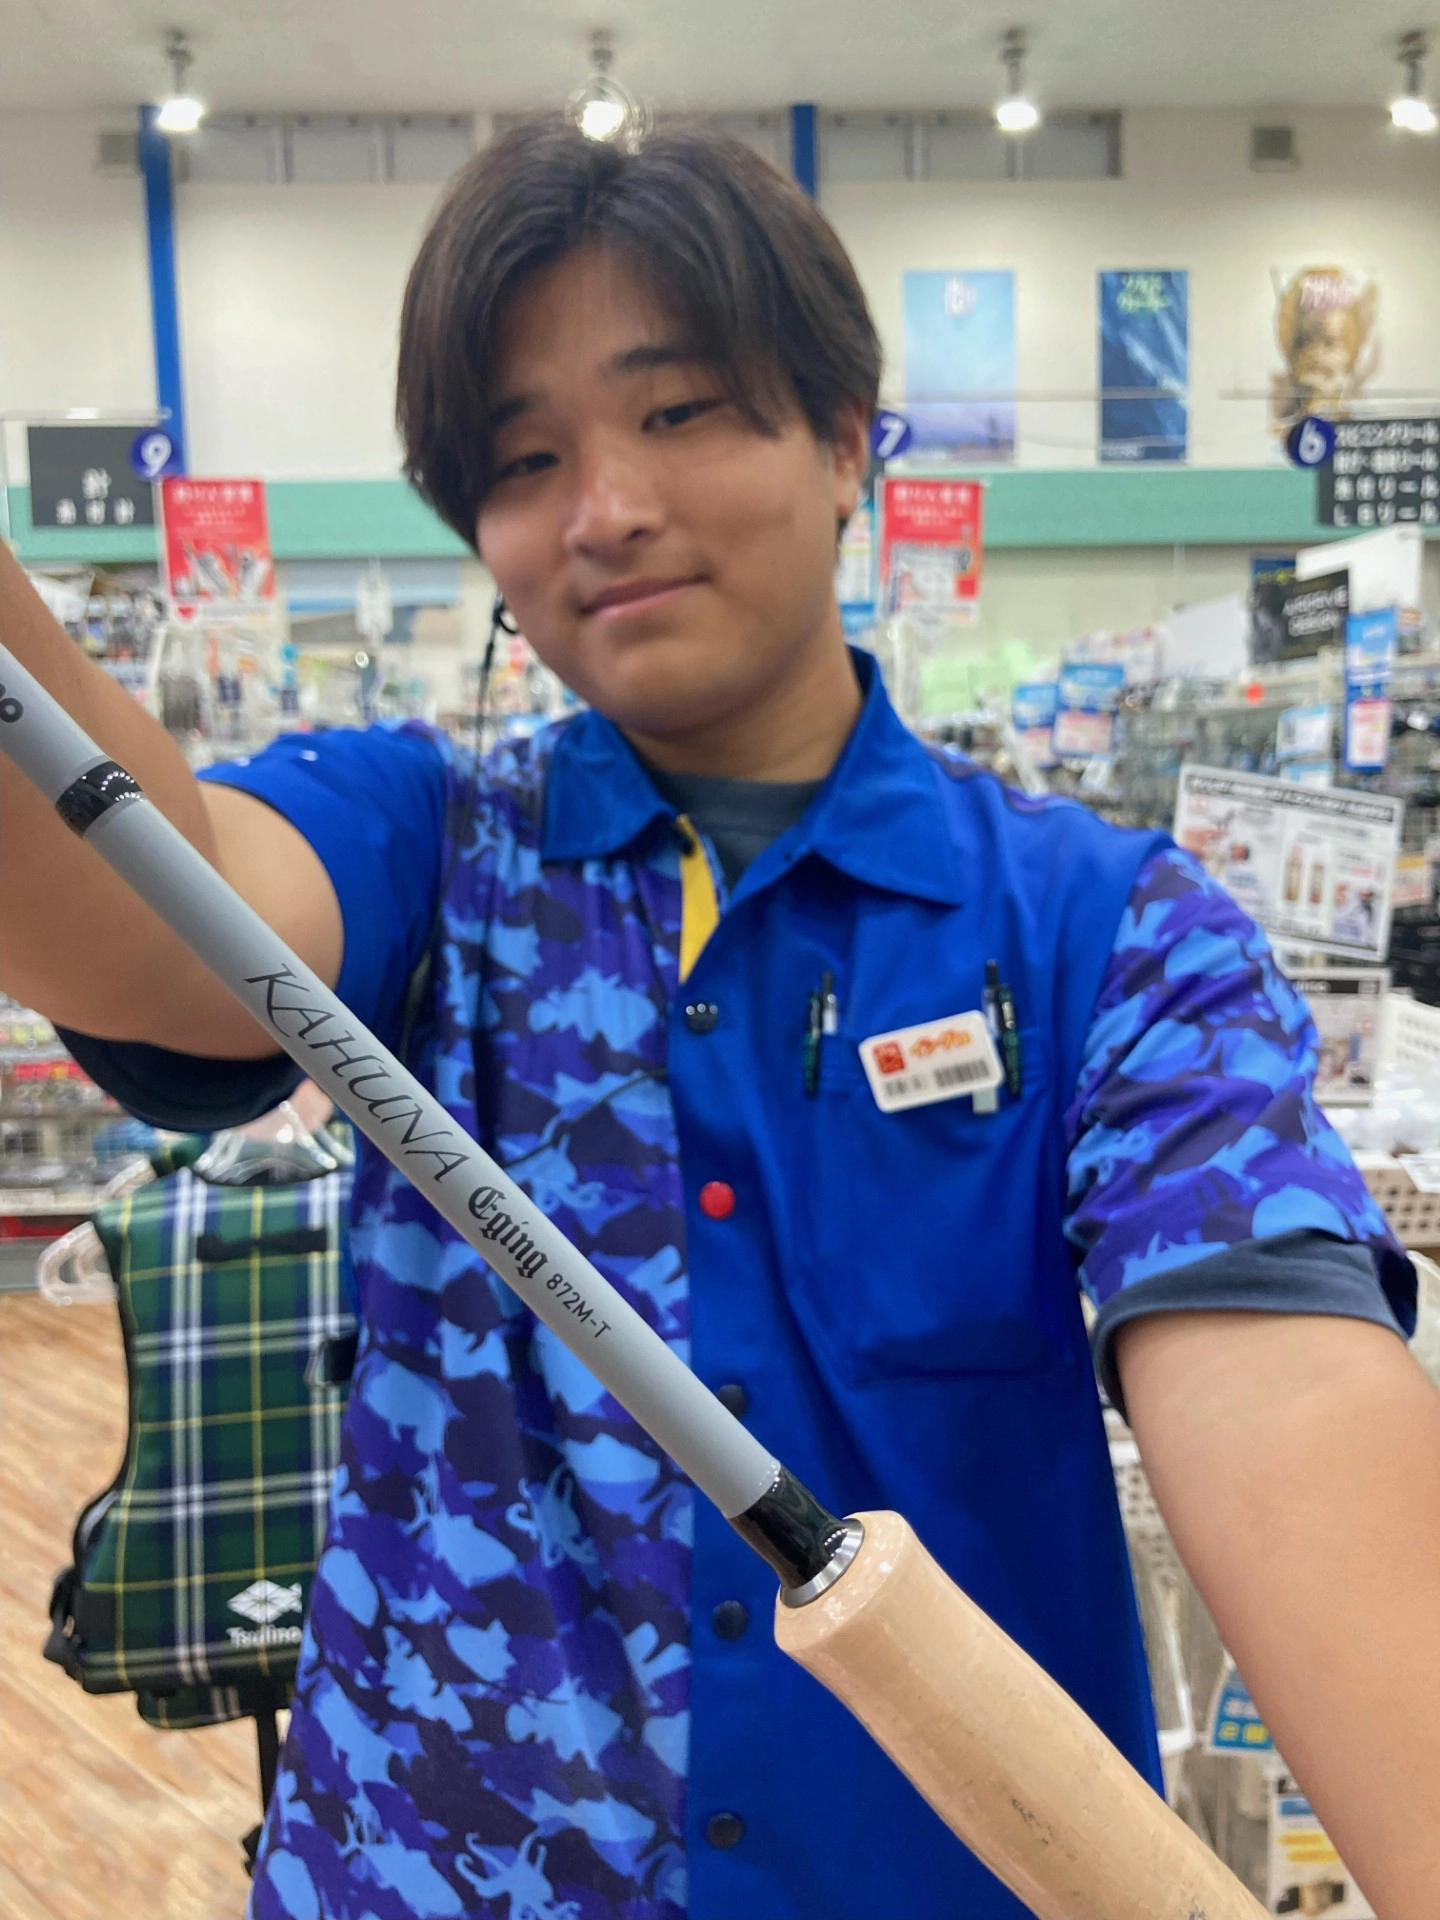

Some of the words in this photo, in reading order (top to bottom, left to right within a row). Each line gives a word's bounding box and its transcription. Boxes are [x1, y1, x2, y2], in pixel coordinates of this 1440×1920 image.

[141, 432, 172, 478] 9
[877, 416, 906, 459] 7
[1298, 419, 1327, 464] 6
[243, 963, 471, 1184] KAHUNA
[467, 1185, 549, 1279] Eging
[546, 1272, 612, 1340] 872M-T
